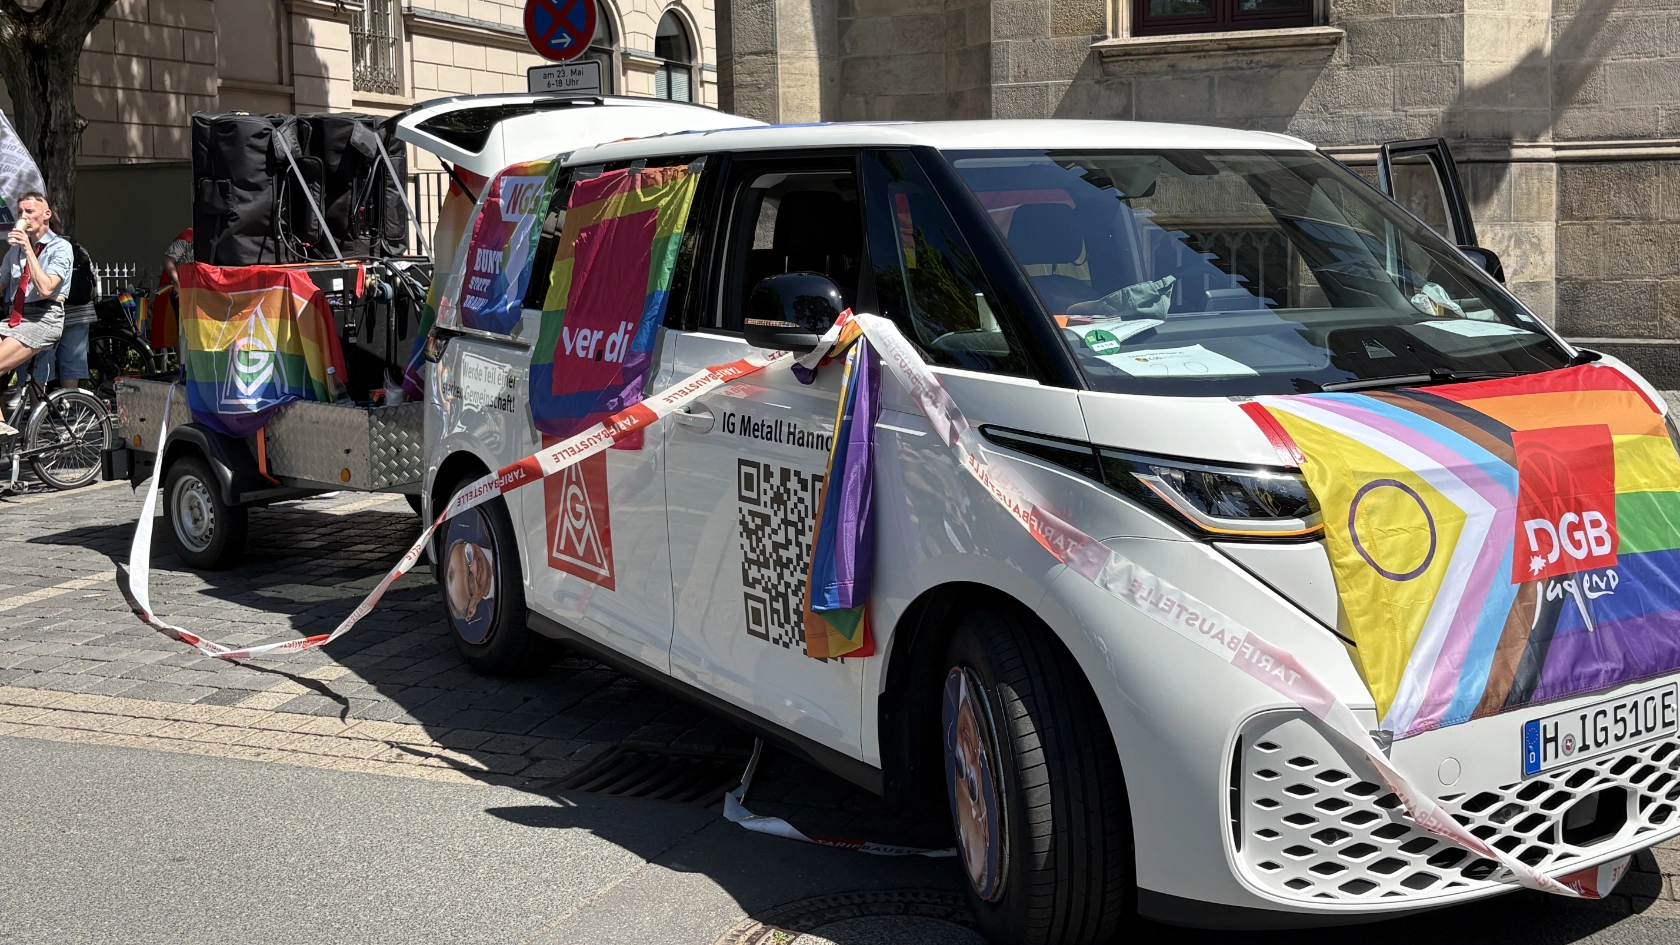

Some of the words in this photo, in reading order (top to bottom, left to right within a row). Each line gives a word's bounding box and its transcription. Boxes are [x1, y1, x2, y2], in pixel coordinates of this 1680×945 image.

[542, 71, 555, 80] am
[556, 69, 568, 78] 23.
[570, 67, 584, 77] Mai
[546, 80, 563, 88] 6-18
[565, 78, 580, 87] Uhr
[473, 247, 504, 275] BUNT
[468, 275, 492, 293] STATT
[1095, 330, 1106, 342] 4
[462, 359, 483, 382] Werde
[484, 366, 496, 385] Teil
[497, 370, 516, 389] einer
[464, 385, 516, 413] Gemeinschaft!
[722, 411, 736, 434] IG
[739, 414, 783, 444] Metall
[786, 422, 834, 453] Hanno
[1523, 510, 1612, 575] DGB
[1542, 721, 1559, 762] H
[1529, 751, 1536, 764] D
